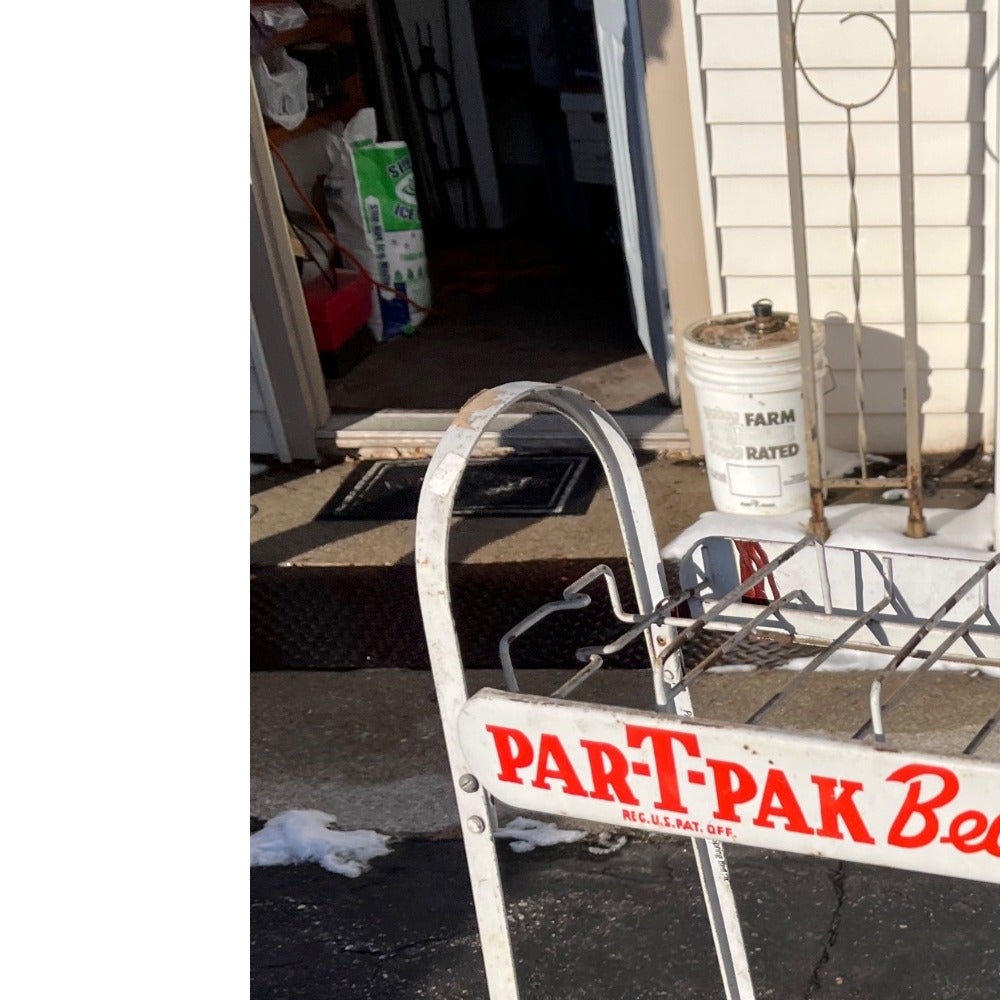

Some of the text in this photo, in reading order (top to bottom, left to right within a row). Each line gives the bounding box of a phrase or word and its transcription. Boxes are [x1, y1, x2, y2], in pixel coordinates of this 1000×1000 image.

[744, 408, 796, 427] FARM
[745, 443, 800, 460] RATED
[485, 724, 876, 845] PAR-T-PAK
